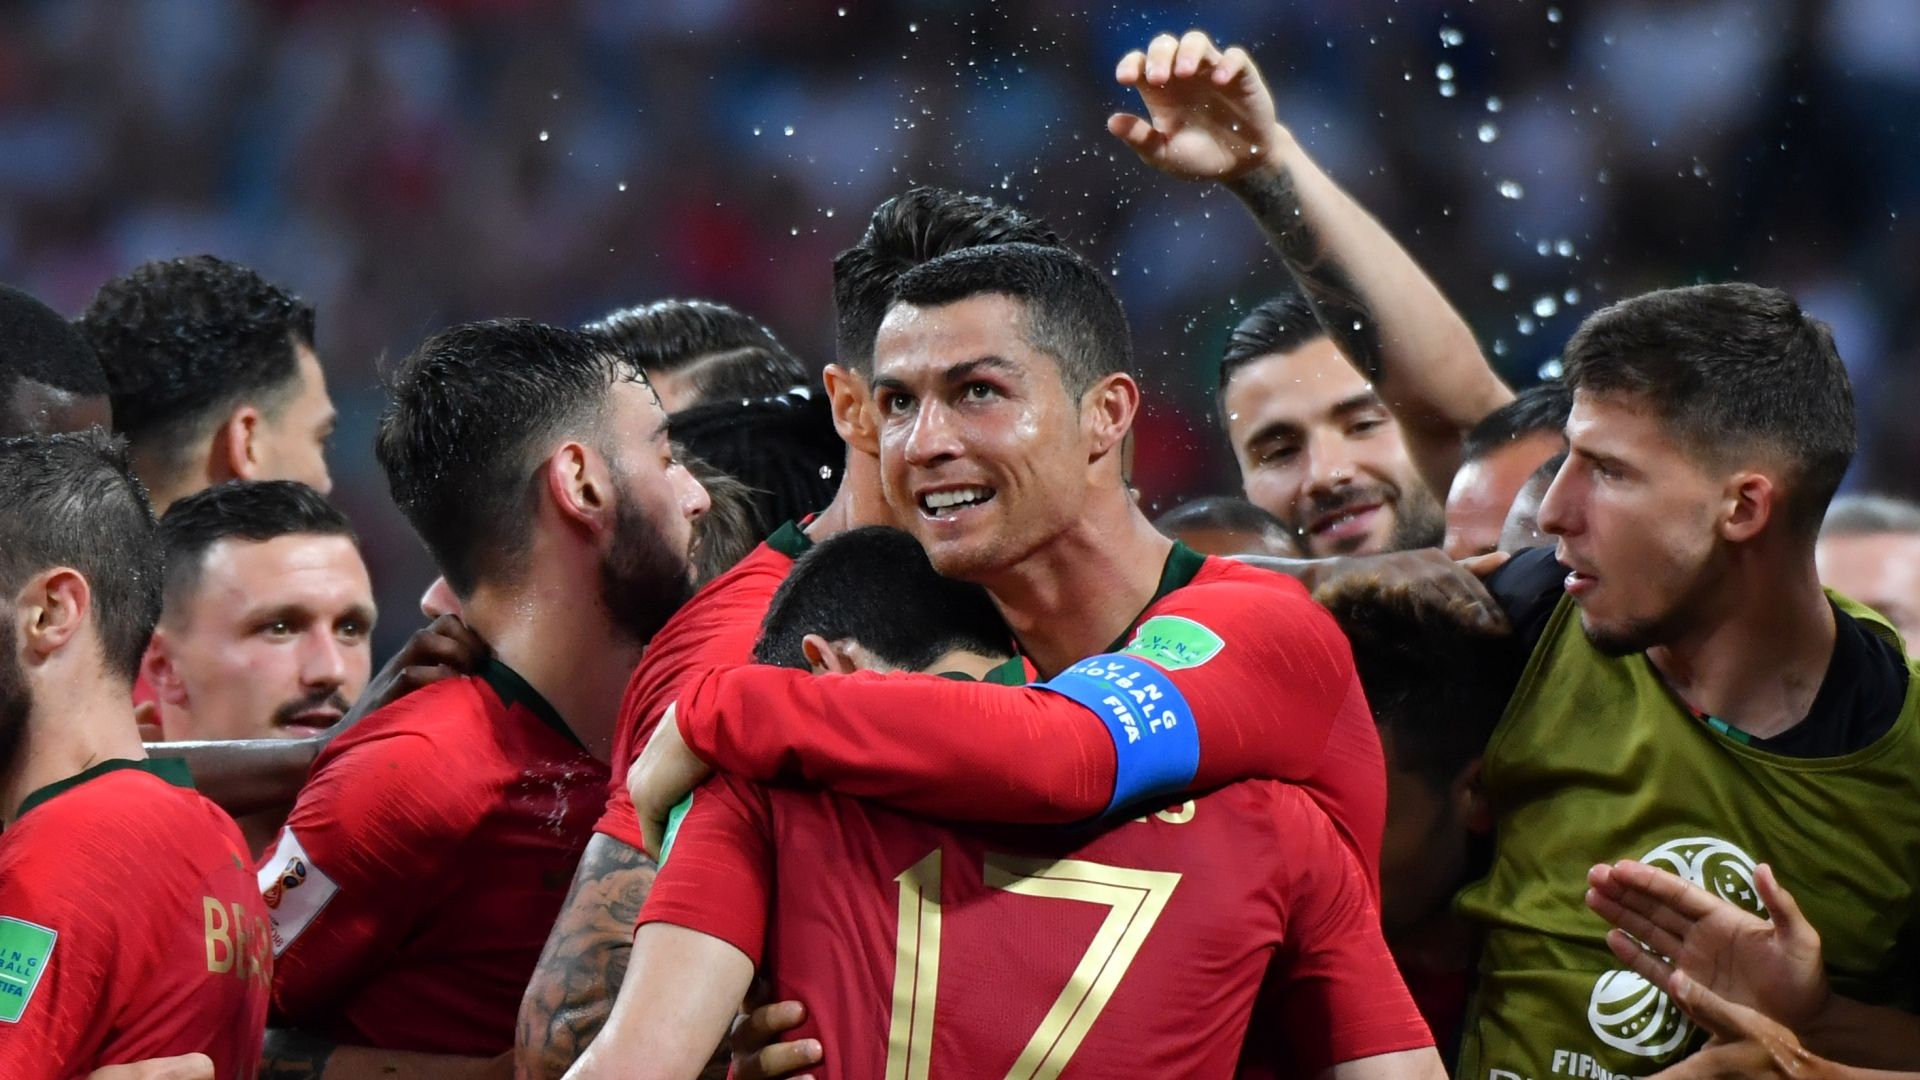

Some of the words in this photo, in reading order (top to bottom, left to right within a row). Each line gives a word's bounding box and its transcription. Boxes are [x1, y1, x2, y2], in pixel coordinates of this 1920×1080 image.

[1087, 660, 1176, 729] IVING
[1102, 695, 1140, 744] FIFA
[885, 846, 1183, 1080] 17
